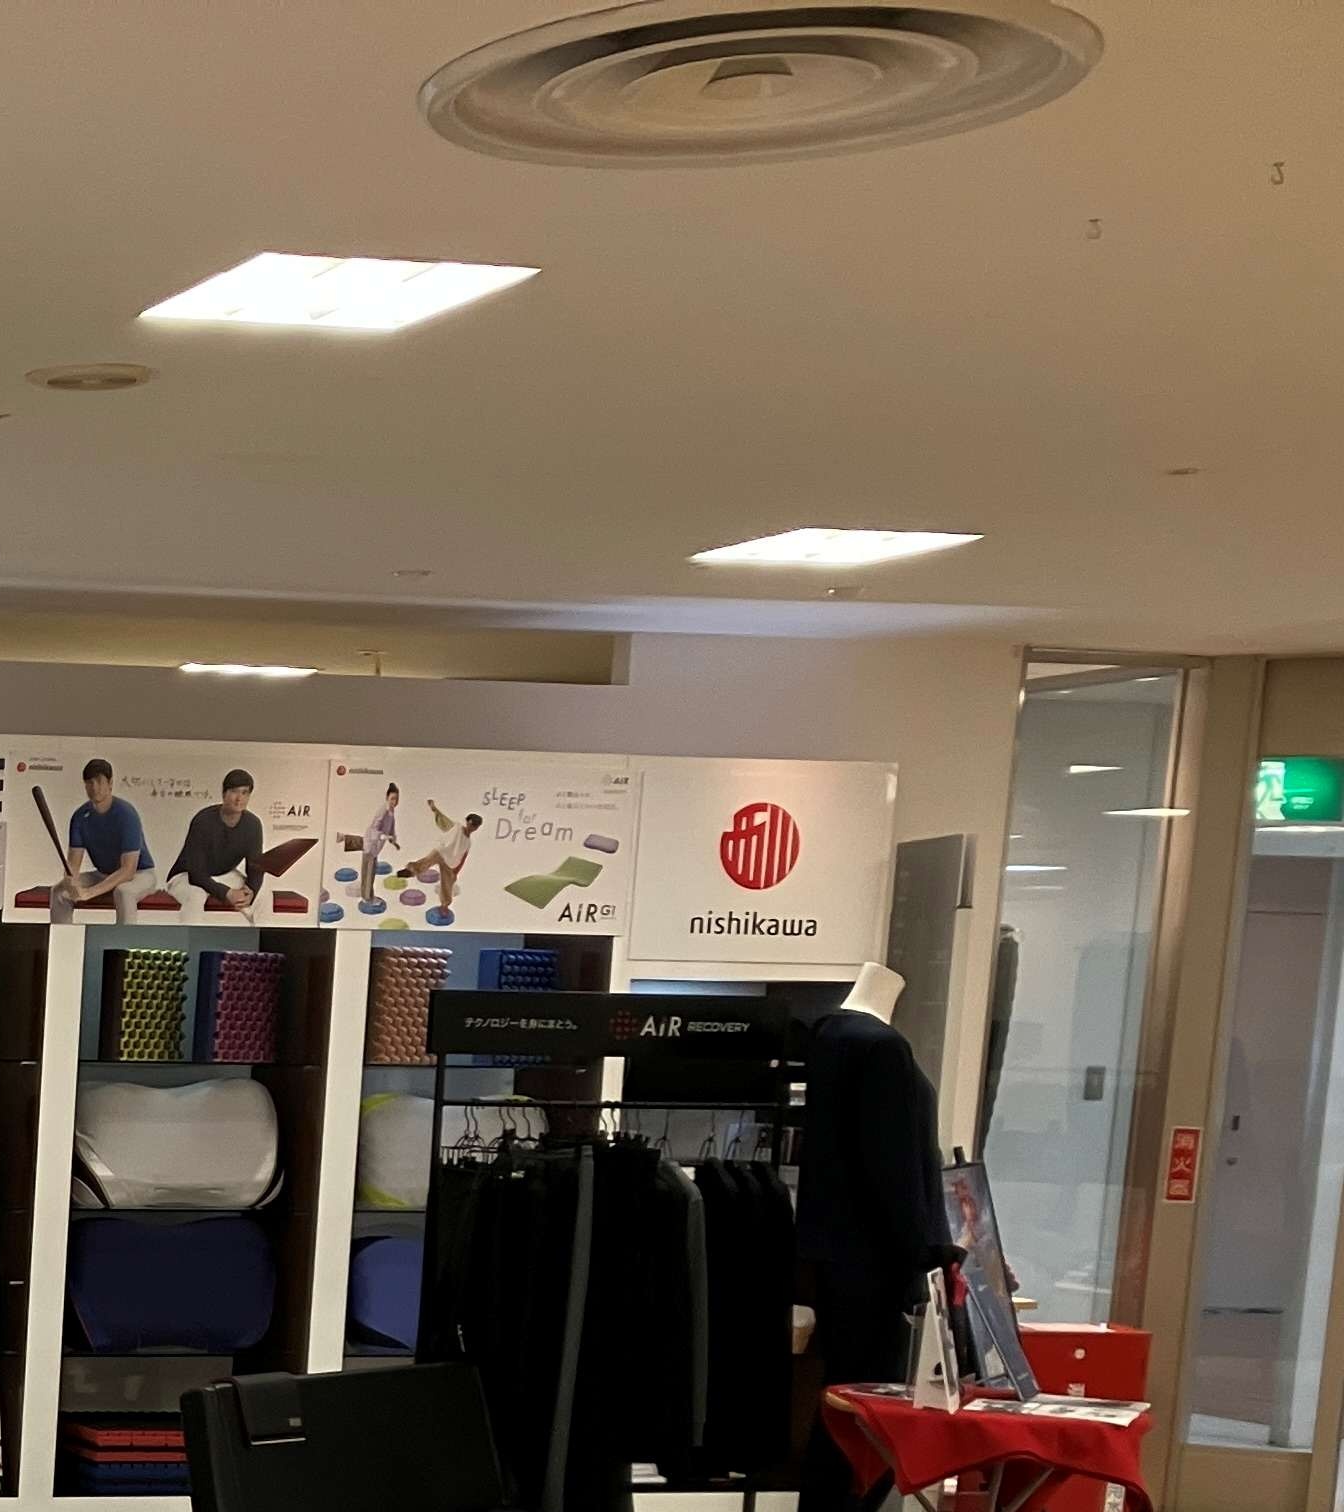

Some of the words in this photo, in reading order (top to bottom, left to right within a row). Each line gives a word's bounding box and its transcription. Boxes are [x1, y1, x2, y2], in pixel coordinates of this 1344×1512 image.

[482, 787, 526, 811] SLEEP
[496, 818, 574, 842] Dream
[689, 911, 818, 937] nishikawa
[687, 1021, 750, 1033] RECOVERY
